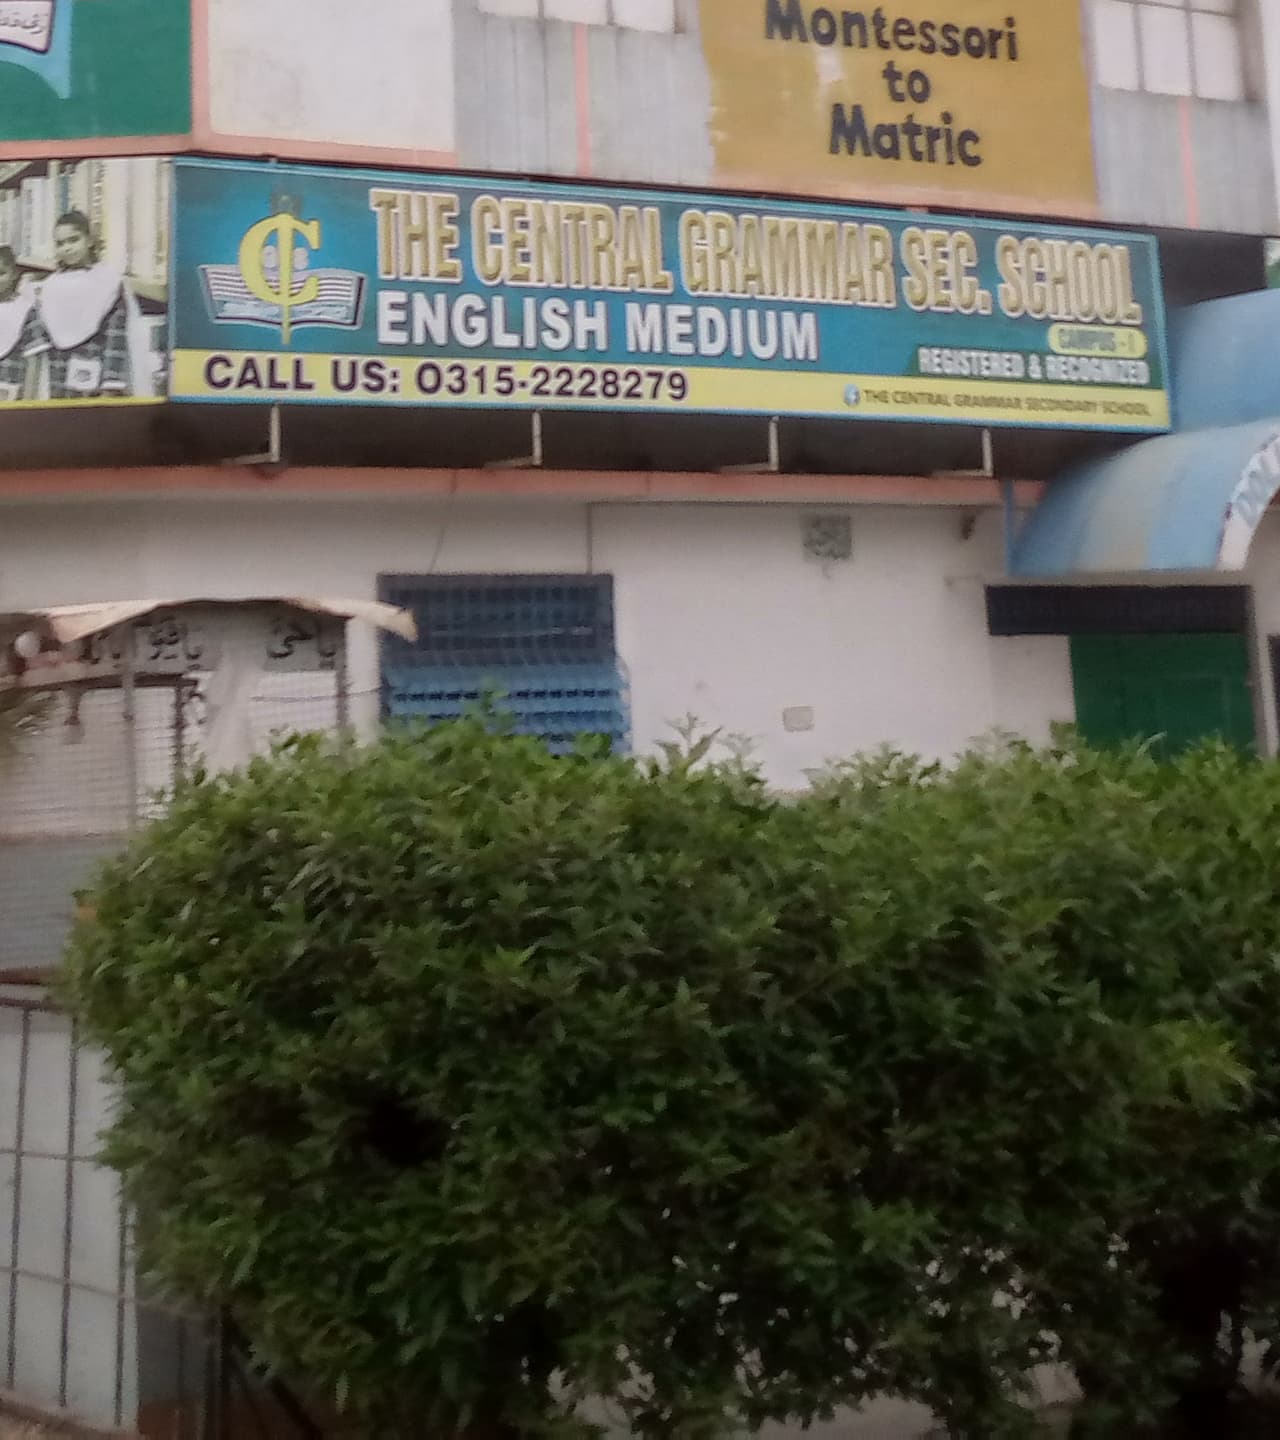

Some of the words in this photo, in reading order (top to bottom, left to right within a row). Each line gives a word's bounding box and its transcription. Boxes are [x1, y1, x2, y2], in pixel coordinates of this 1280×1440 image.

[881, 60, 931, 104] to
[829, 102, 984, 168] Matric
[369, 187, 463, 284] THE
[470, 193, 674, 296] CENTRAL
[678, 208, 897, 310] GRAMMAR
[900, 226, 993, 316] SEC.
[995, 234, 1143, 326] SCHOOL
[376, 289, 608, 353] ENGLISH
[624, 301, 819, 362] MEDIUM
[204, 353, 315, 392] CALL
[331, 358, 401, 394] US:
[414, 360, 689, 403] 0315-2228279
[918, 346, 1025, 379] REGISTERED
[1028, 352, 1043, 381] &
[1045, 354, 1151, 386] RECOGNIZED
[862, 387, 889, 404] THE
[892, 390, 951, 408] CENTRAL
[953, 393, 1022, 411] GRAMMAR
[1100, 400, 1152, 418] SCHOOL
